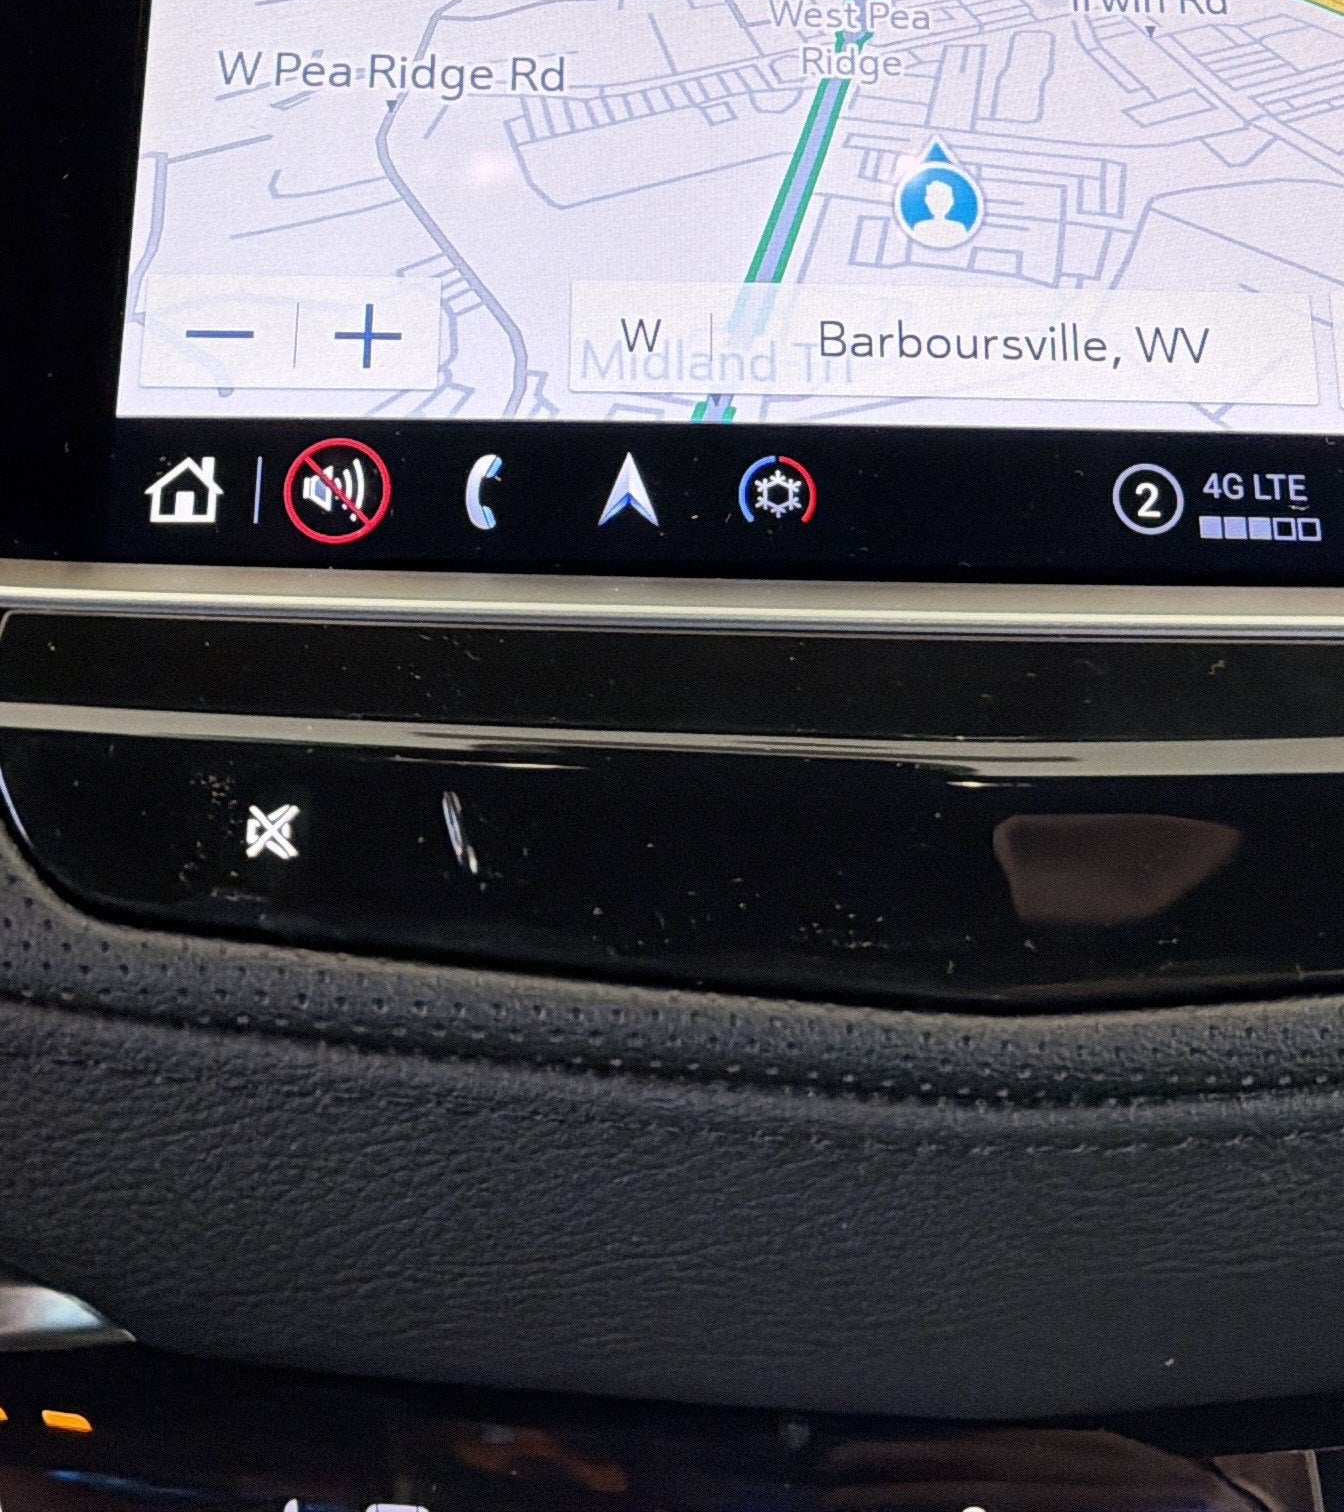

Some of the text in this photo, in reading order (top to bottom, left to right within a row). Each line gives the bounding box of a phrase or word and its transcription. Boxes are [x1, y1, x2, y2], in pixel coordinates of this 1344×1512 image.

[769, 0, 930, 30] West Pea
[217, 50, 566, 101] W Pea Ridge Rd
[802, 46, 902, 85] Ridge
[620, 317, 662, 353] W
[818, 319, 1210, 370] Barboursville, WV
[580, 338, 777, 382] Midland
[1135, 482, 1162, 519] 2
[1202, 472, 1309, 502] 4G LTE
